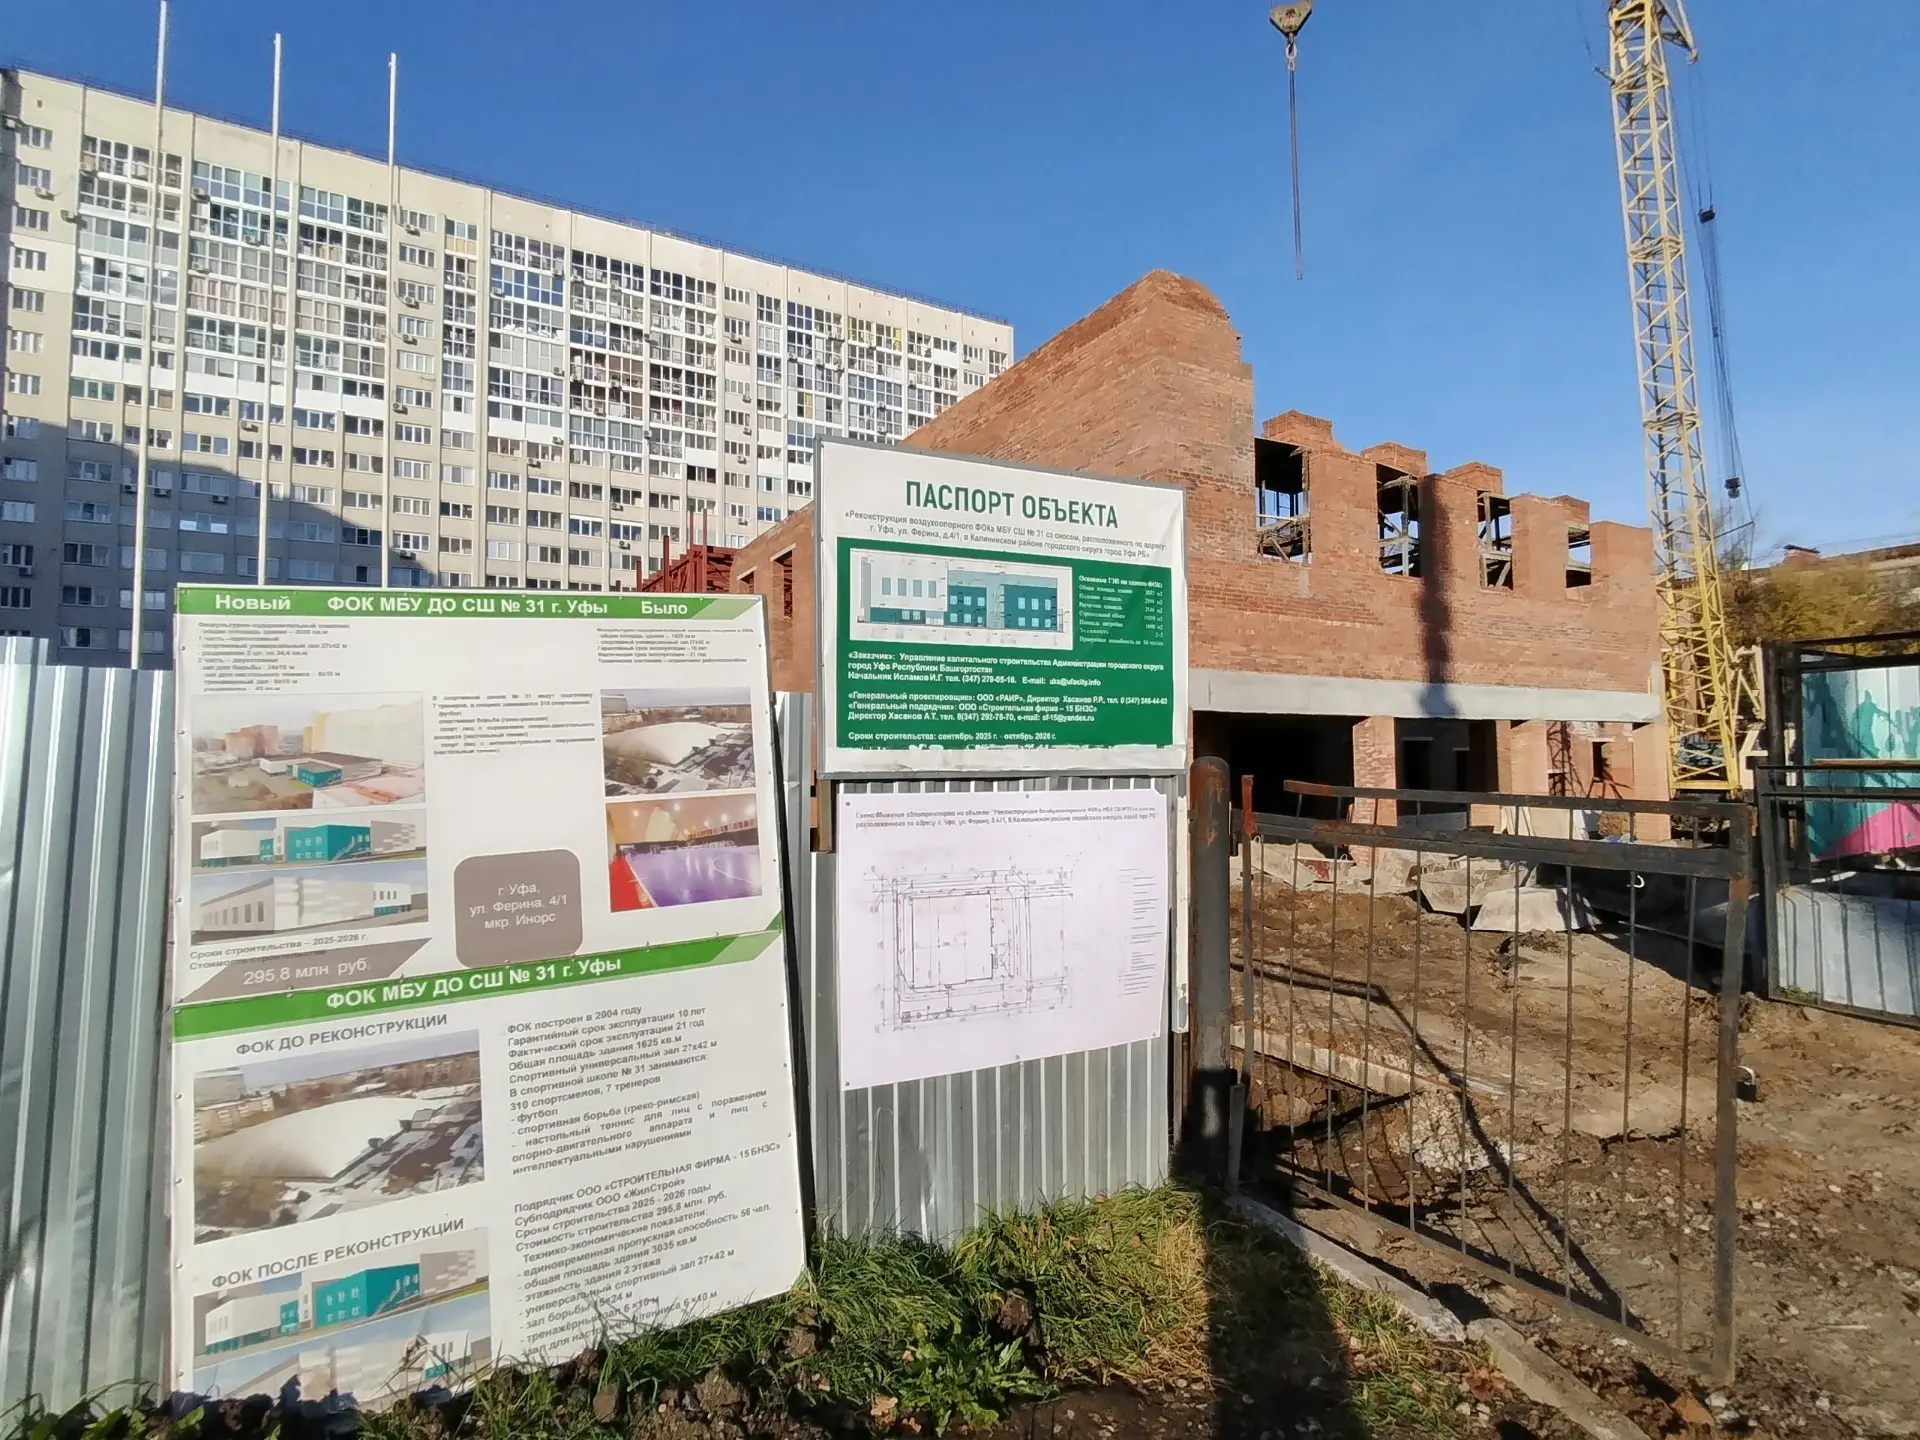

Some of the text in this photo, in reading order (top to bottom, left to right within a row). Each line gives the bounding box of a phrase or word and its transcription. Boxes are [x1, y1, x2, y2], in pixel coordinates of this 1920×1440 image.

[906, 481, 1117, 527] ПАСПОРТ ОБЪЕКТА
[844, 510, 907, 523] «Реконструкция
[909, 517, 973, 530] воздухоопорного
[975, 523, 994, 532] ФОКа
[996, 525, 1011, 534] МБУ
[1013, 526, 1025, 535] СШ
[1026, 528, 1034, 536] №
[1036, 529, 1043, 537] 31
[1054, 533, 1080, 541] сносом,
[1081, 536, 1133, 546] расположенного
[1143, 542, 1166, 551] адресу:
[869, 524, 876, 532] г.
[878, 523, 895, 535] Уфа,
[897, 528, 909, 536] ул.
[942, 531, 962, 540] д.4/1,
[970, 534, 1016, 545] Калининском
[1044, 542, 1080, 551] городского
[1104, 548, 1122, 556] город
[1137, 550, 1152, 558] РБ»
[215, 594, 290, 609] Новый
[328, 596, 607, 616] ФОК МБУ ДО СШ № 31 г. Уфы
[641, 600, 687, 614] Было
[847, 662, 992, 673] город Уфа Республики Башкортостан
[848, 731, 873, 740] Сроки
[938, 732, 973, 740] сентябрь
[975, 732, 991, 740] 2025
[1004, 732, 1033, 740] октябрь
[1034, 732, 1050, 740] 2026
[548, 894, 568, 906] 4/1
[516, 913, 556, 925] Инорс
[187, 933, 359, 959] Сроки строительства 2025-2026
[295, 966, 329, 978] млн
[327, 958, 620, 1008] ФОК МБУ ДО СШ № 31 г. Уфы
[236, 1014, 447, 1054] ФОК ДО РЕКОНСТРУКЦИИ
[507, 1022, 532, 1033] ФОК
[534, 1016, 583, 1029] построен
[595, 1008, 618, 1020] 2004
[620, 1006, 641, 1015] году
[507, 1007, 705, 1046] Гарантийный срок эксплуатации 10 лет
[508, 1019, 704, 1057] Фактический срок эксплуатации 21 год
[508, 1035, 681, 1071] Общая площадь здания 1625 кв.м
[509, 1064, 576, 1083] Спортивный
[579, 1050, 660, 1070] универсальный
[663, 1047, 679, 1055] зал
[509, 1054, 707, 1097] В спортивной школе № 31 занимаются:
[510, 1076, 660, 1111] 310 спортсменов, 7 тренеров
[517, 1092, 699, 1135] спортивная борьба (греко-римская)
[517, 1108, 558, 1123] футбол
[525, 1127, 590, 1146] настольный
[600, 1117, 634, 1130] теннис
[643, 1111, 662, 1122] для
[671, 1106, 690, 1116] лиц
[711, 1090, 766, 1107] поражением
[512, 1130, 691, 1174] интеллектуальными нарушениями
[514, 1193, 573, 1213] Подрядчик
[576, 1184, 601, 1198] ООО
[604, 1163, 692, 1190] «СТРОИТЕЛЬНАЯ
[695, 1154, 730, 1168] ФИРМА
[514, 1178, 684, 1226] Субподрядчик ООО «ЖилСтрой»
[515, 1190, 726, 1251] Стоимость строительства 295,8 млн. руб.
[212, 1219, 463, 1287] ФОК ПОСЛЕ РЕКОНСТРУКЦИИ
